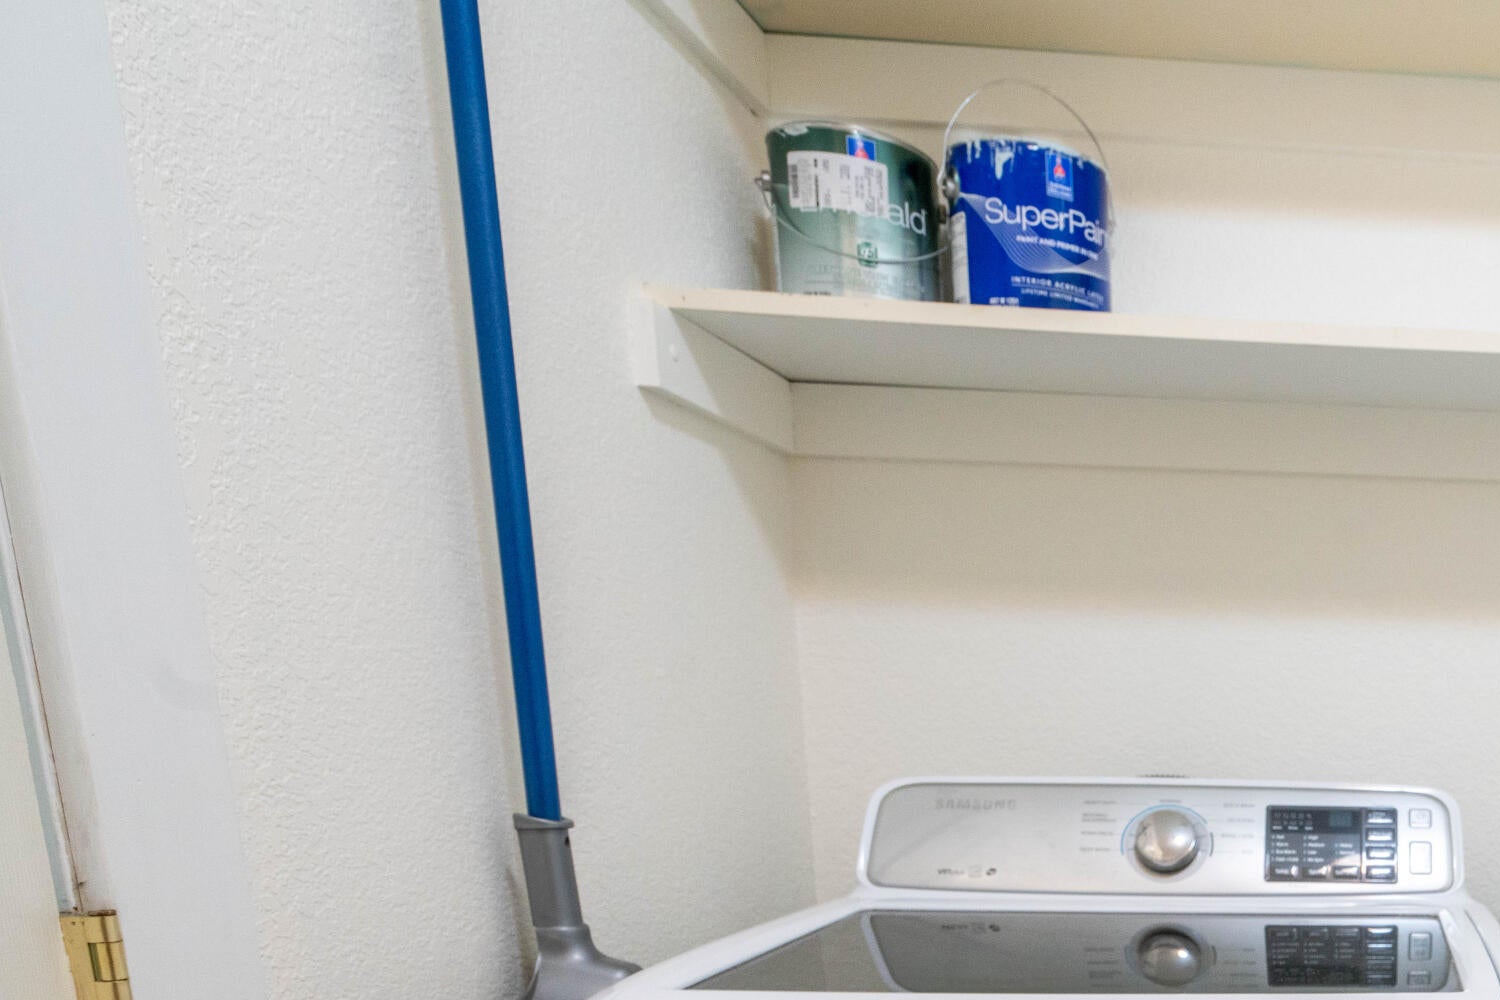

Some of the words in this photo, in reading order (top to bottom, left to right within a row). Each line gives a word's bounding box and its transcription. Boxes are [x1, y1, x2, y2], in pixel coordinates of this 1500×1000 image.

[985, 197, 1106, 247] SuperPain
[1010, 276, 1052, 286] INTERIOR
[935, 798, 1018, 810] SAMSUNG
